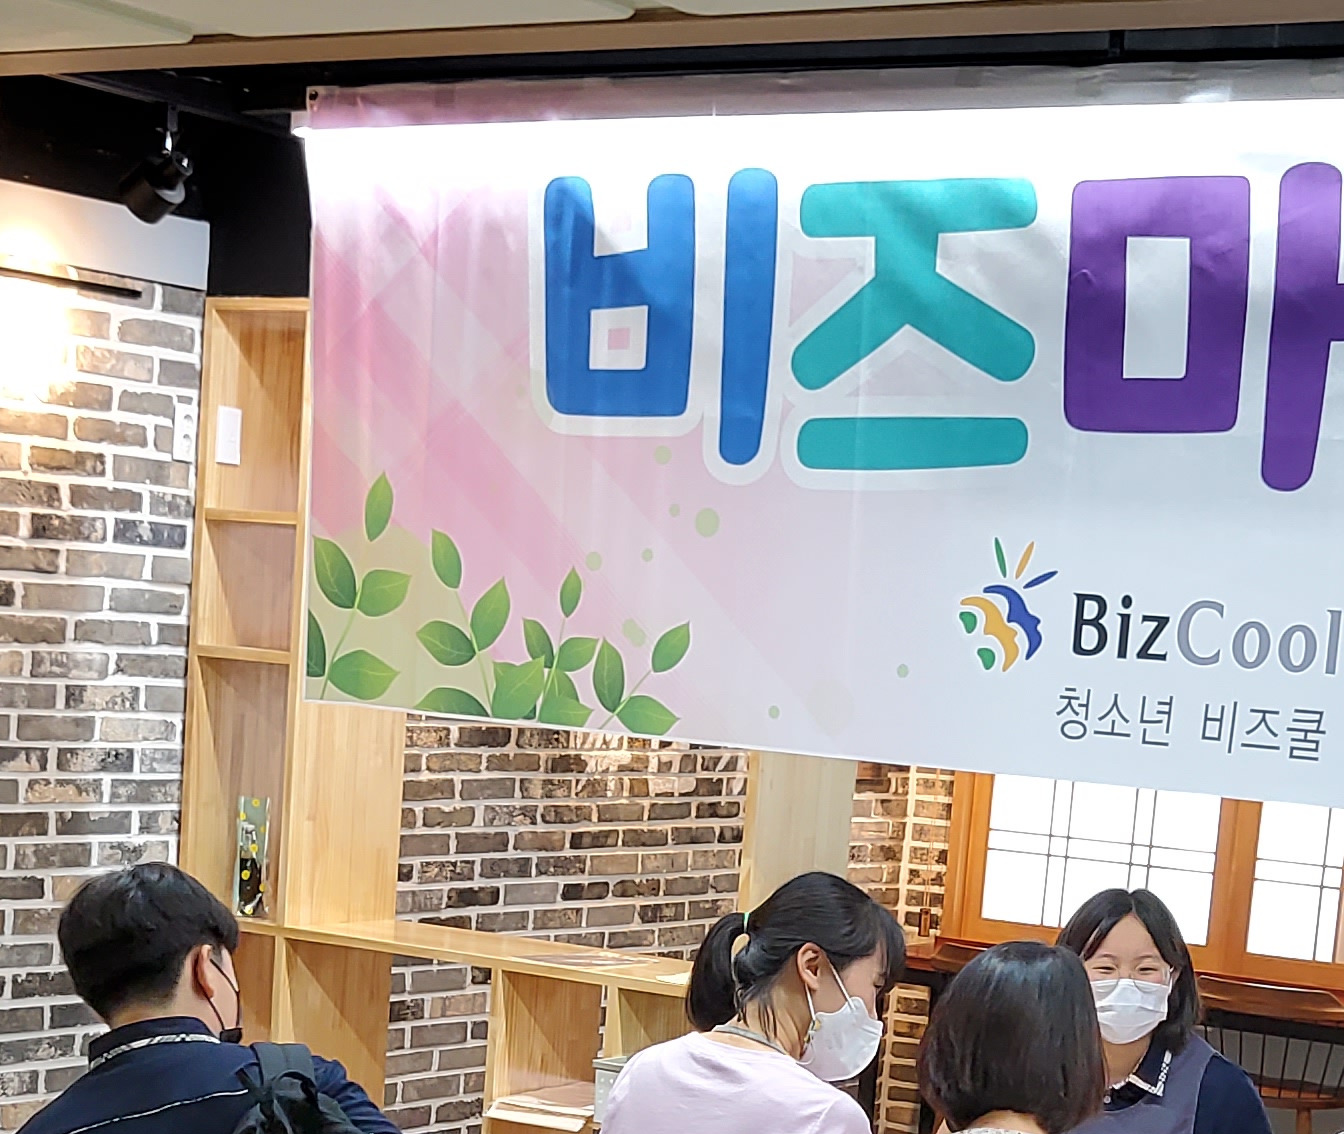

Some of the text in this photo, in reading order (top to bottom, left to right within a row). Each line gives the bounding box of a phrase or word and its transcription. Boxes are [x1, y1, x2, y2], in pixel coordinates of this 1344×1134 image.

[1071, 593, 1343, 677] BizCool
[1054, 686, 1327, 763] 청소년 비즈쿨
